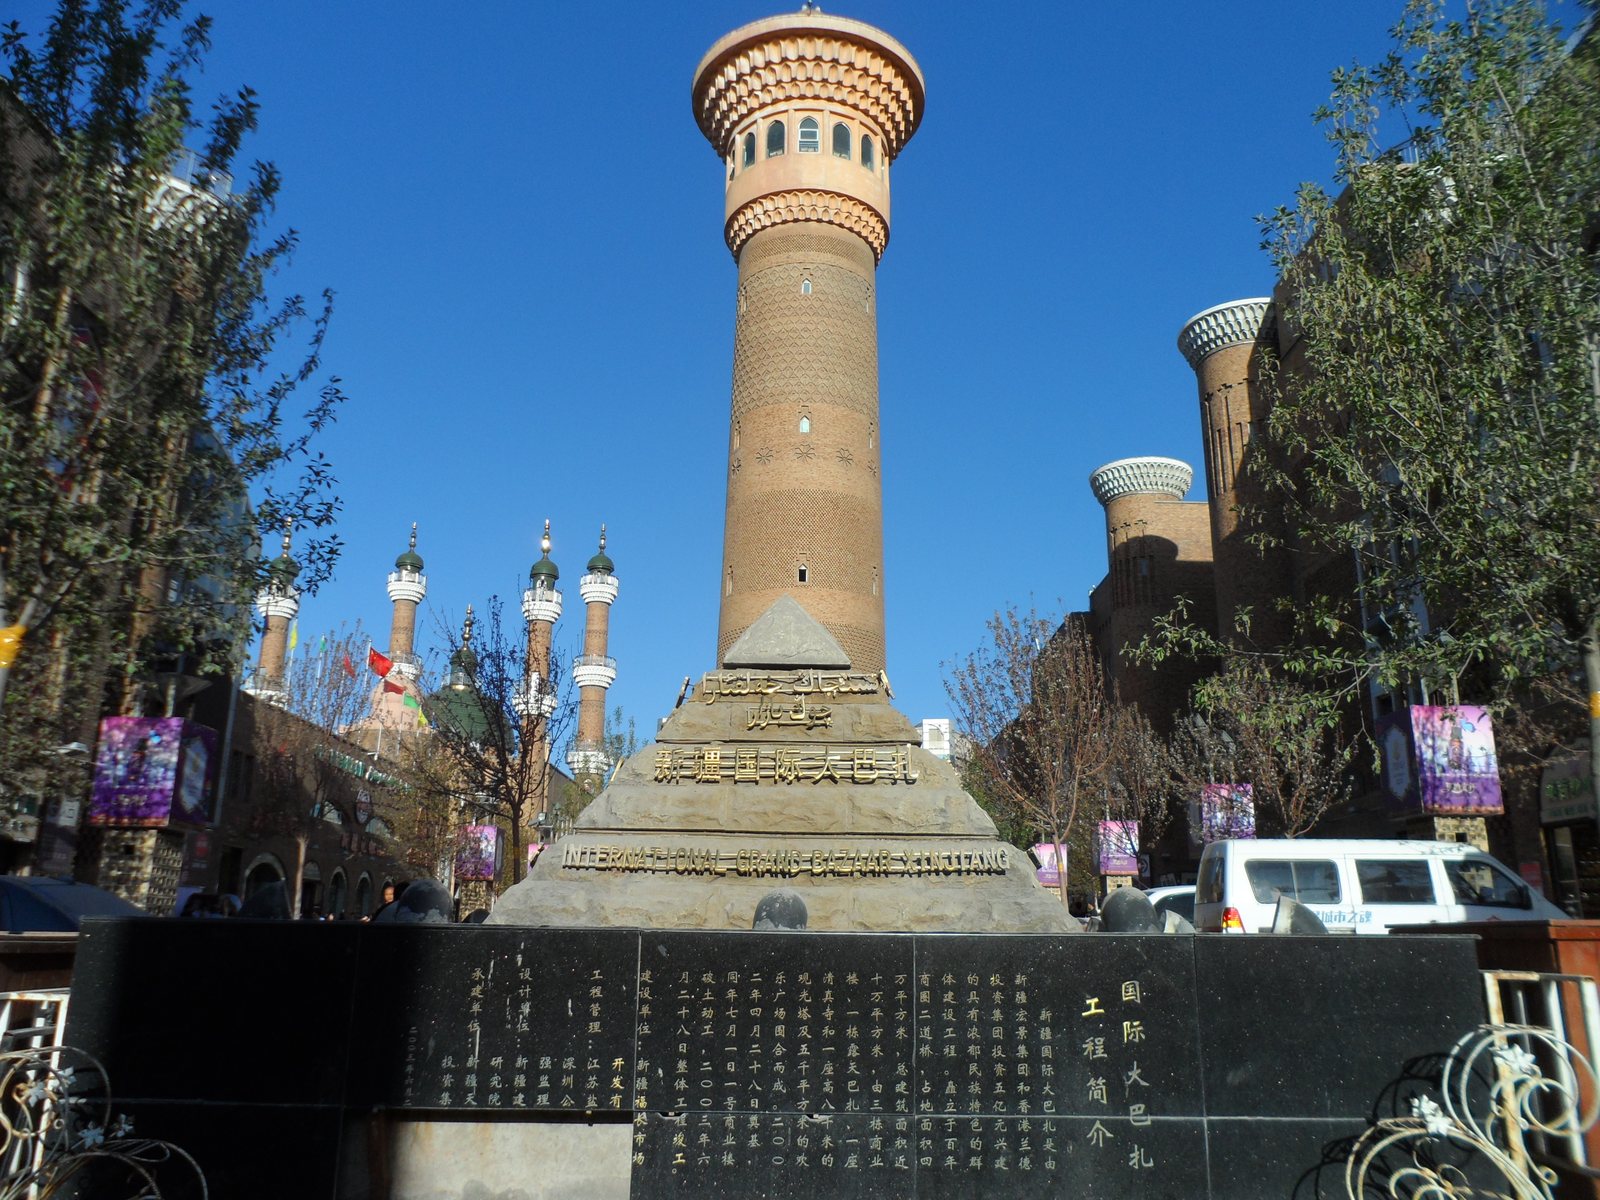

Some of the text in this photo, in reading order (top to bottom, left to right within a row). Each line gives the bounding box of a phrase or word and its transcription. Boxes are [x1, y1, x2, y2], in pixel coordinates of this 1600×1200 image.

[654, 743, 920, 784] 新疆国际大巴扎
[562, 843, 1010, 877] INTERNATIONAL GRAND BAZAAR XINJIANG
[439, 1056, 456, 1106] 投资集
[488, 1057, 504, 1107] 研究院
[536, 1056, 553, 1106] 强监理
[560, 1057, 576, 1107] 深圳公
[609, 1058, 625, 1109] 开发有
[990, 973, 1009, 1171] 投资集团投资五亿元兴建
[1014, 973, 1032, 1171] 新疆宏景集团和香港兰德
[1040, 1009, 1057, 1171] 新疆国际大巴扎是由
[1081, 997, 1114, 1147] 工程简介
[1121, 980, 1154, 1169] 国际大巴扎
